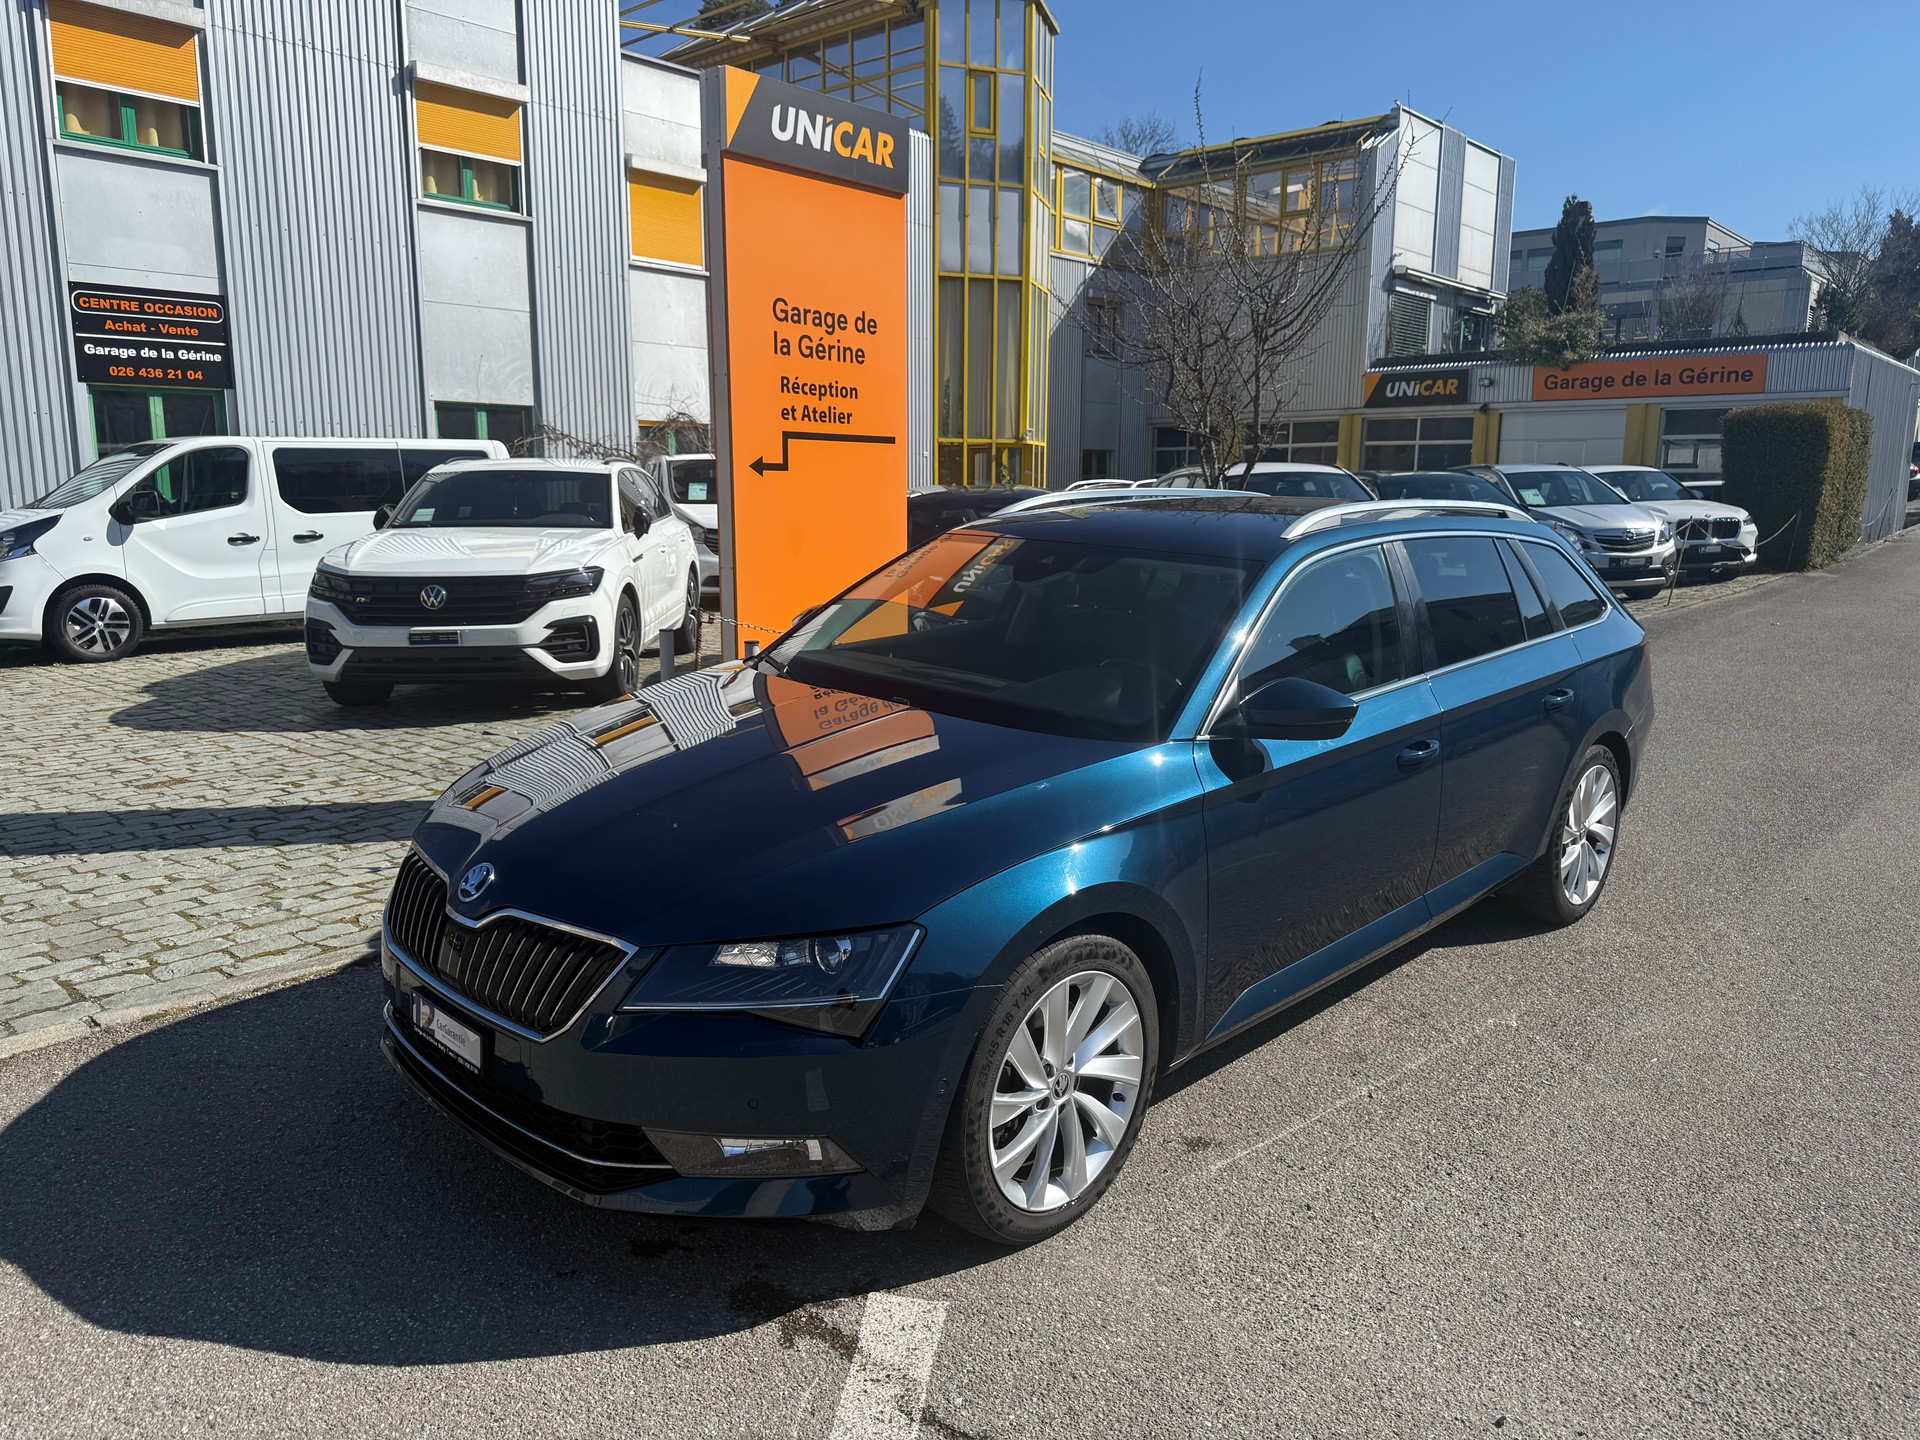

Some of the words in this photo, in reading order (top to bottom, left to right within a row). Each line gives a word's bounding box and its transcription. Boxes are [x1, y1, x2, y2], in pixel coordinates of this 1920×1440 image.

[79, 297, 140, 312] CENTRE
[144, 302, 218, 319] OCCASION
[772, 297, 848, 336] Garage
[854, 311, 878, 335] de
[104, 320, 147, 333] Achat
[158, 323, 200, 336] Vente
[84, 343, 137, 359] Garage
[140, 347, 158, 358] de
[161, 348, 175, 360] la
[178, 349, 223, 362] Gérine
[773, 330, 791, 356] la
[798, 334, 866, 365] Gérine
[109, 366, 135, 377] 026
[138, 367, 164, 379] 436
[167, 369, 183, 380] 21
[186, 370, 204, 381] 04
[1544, 374, 1616, 393] Garage
[1621, 370, 1648, 387] de
[1654, 369, 1672, 386] la
[1678, 366, 1754, 385] Gérine
[780, 375, 859, 401] Réception
[780, 405, 797, 421] et
[801, 405, 853, 425] Atelier
